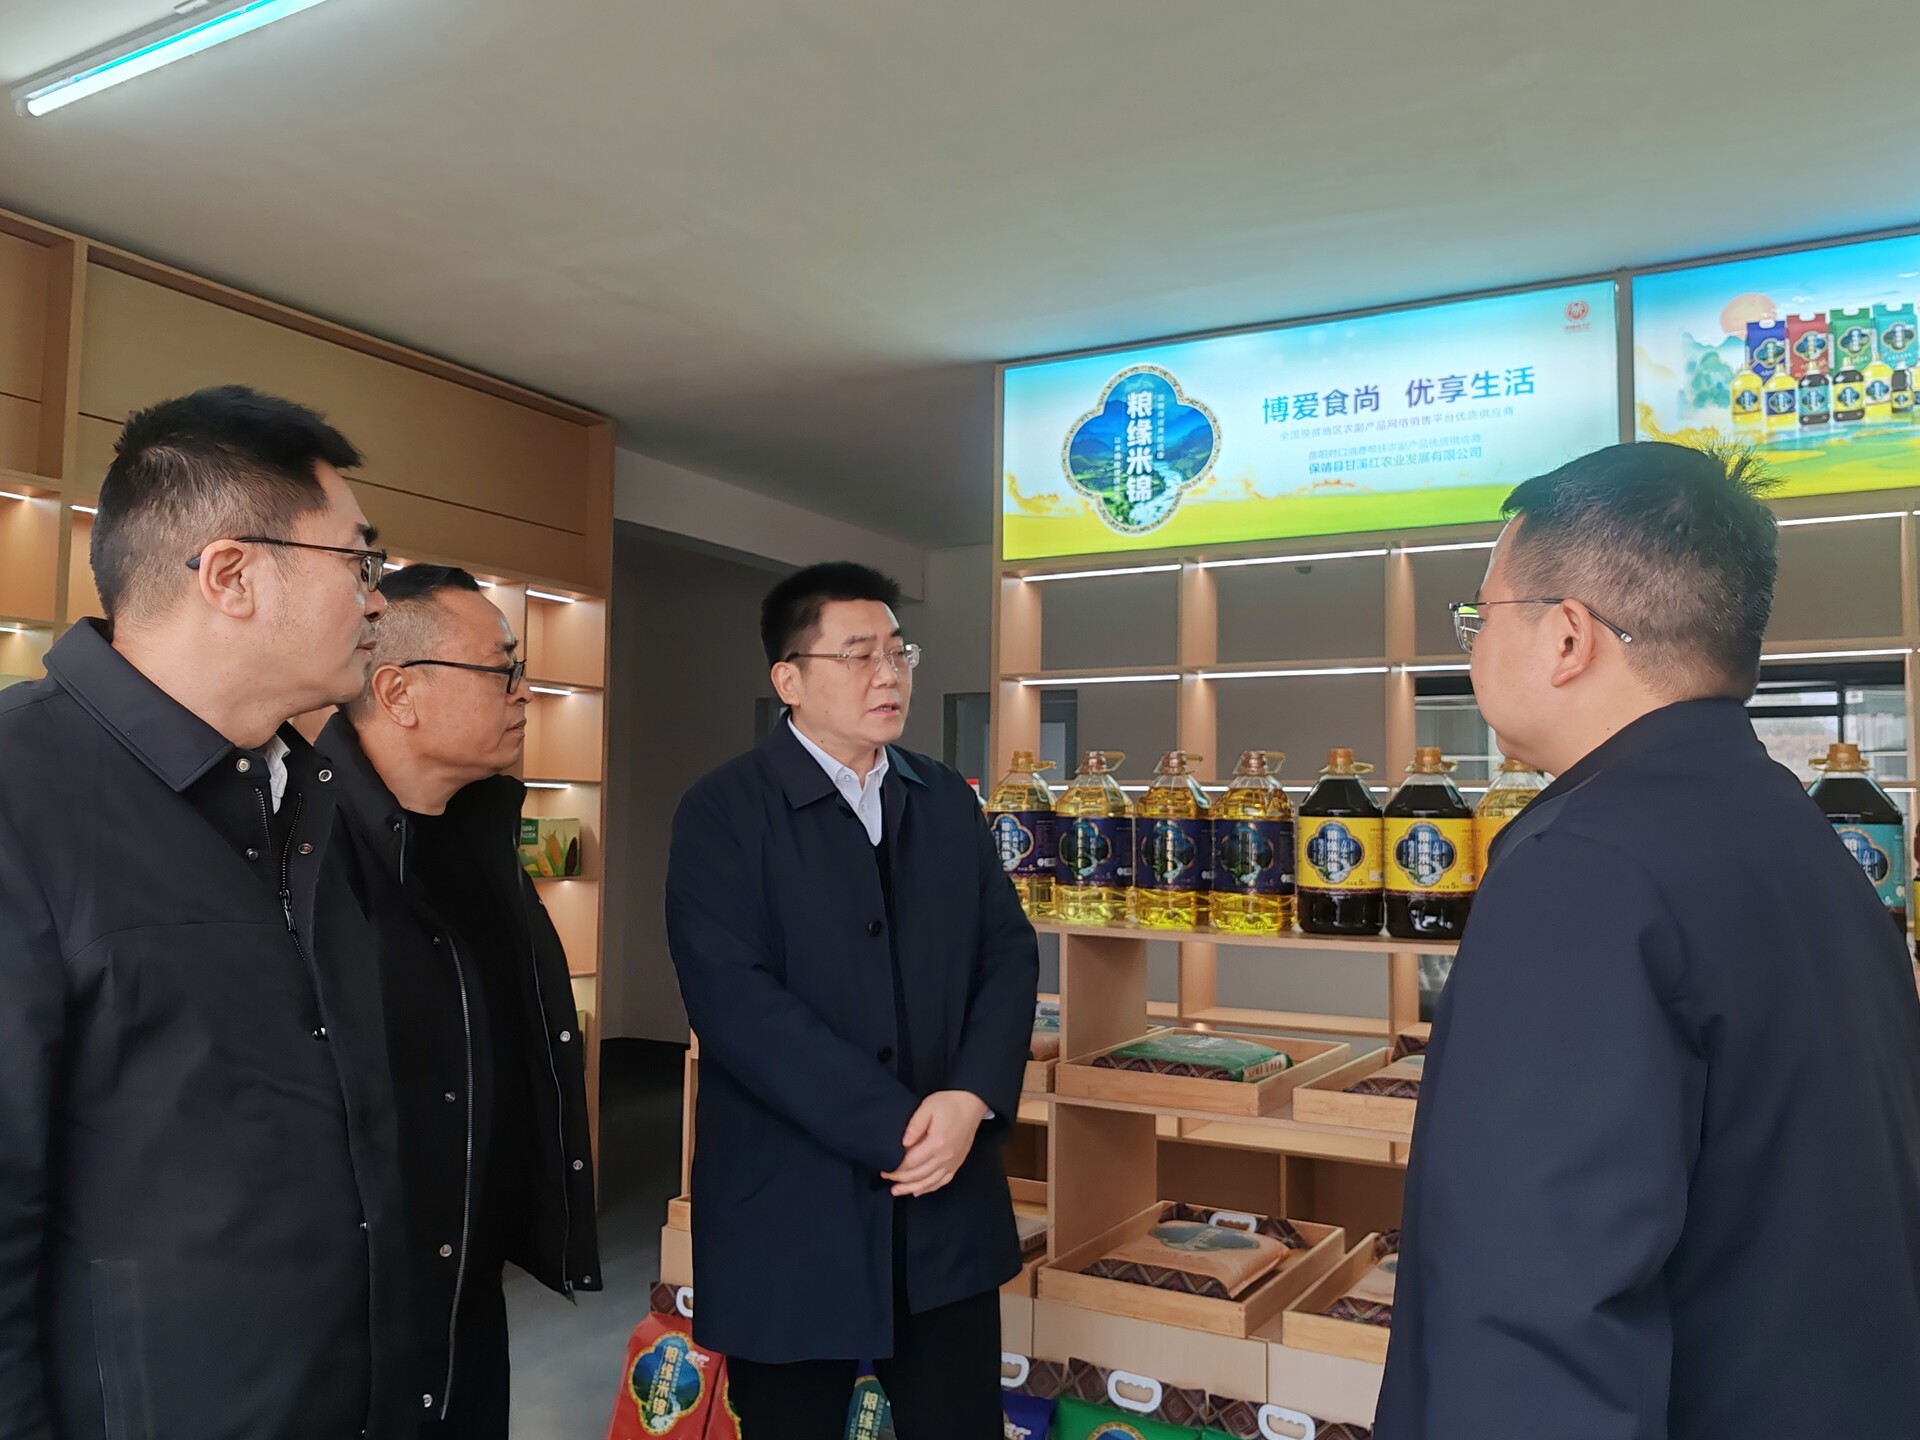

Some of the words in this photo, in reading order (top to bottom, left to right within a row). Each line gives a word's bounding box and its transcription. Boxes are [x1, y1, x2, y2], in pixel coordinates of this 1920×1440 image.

[1263, 383, 1380, 424] 博爱食尚
[1404, 366, 1535, 408] 优享生活
[1126, 390, 1153, 503] 粮缘米锦
